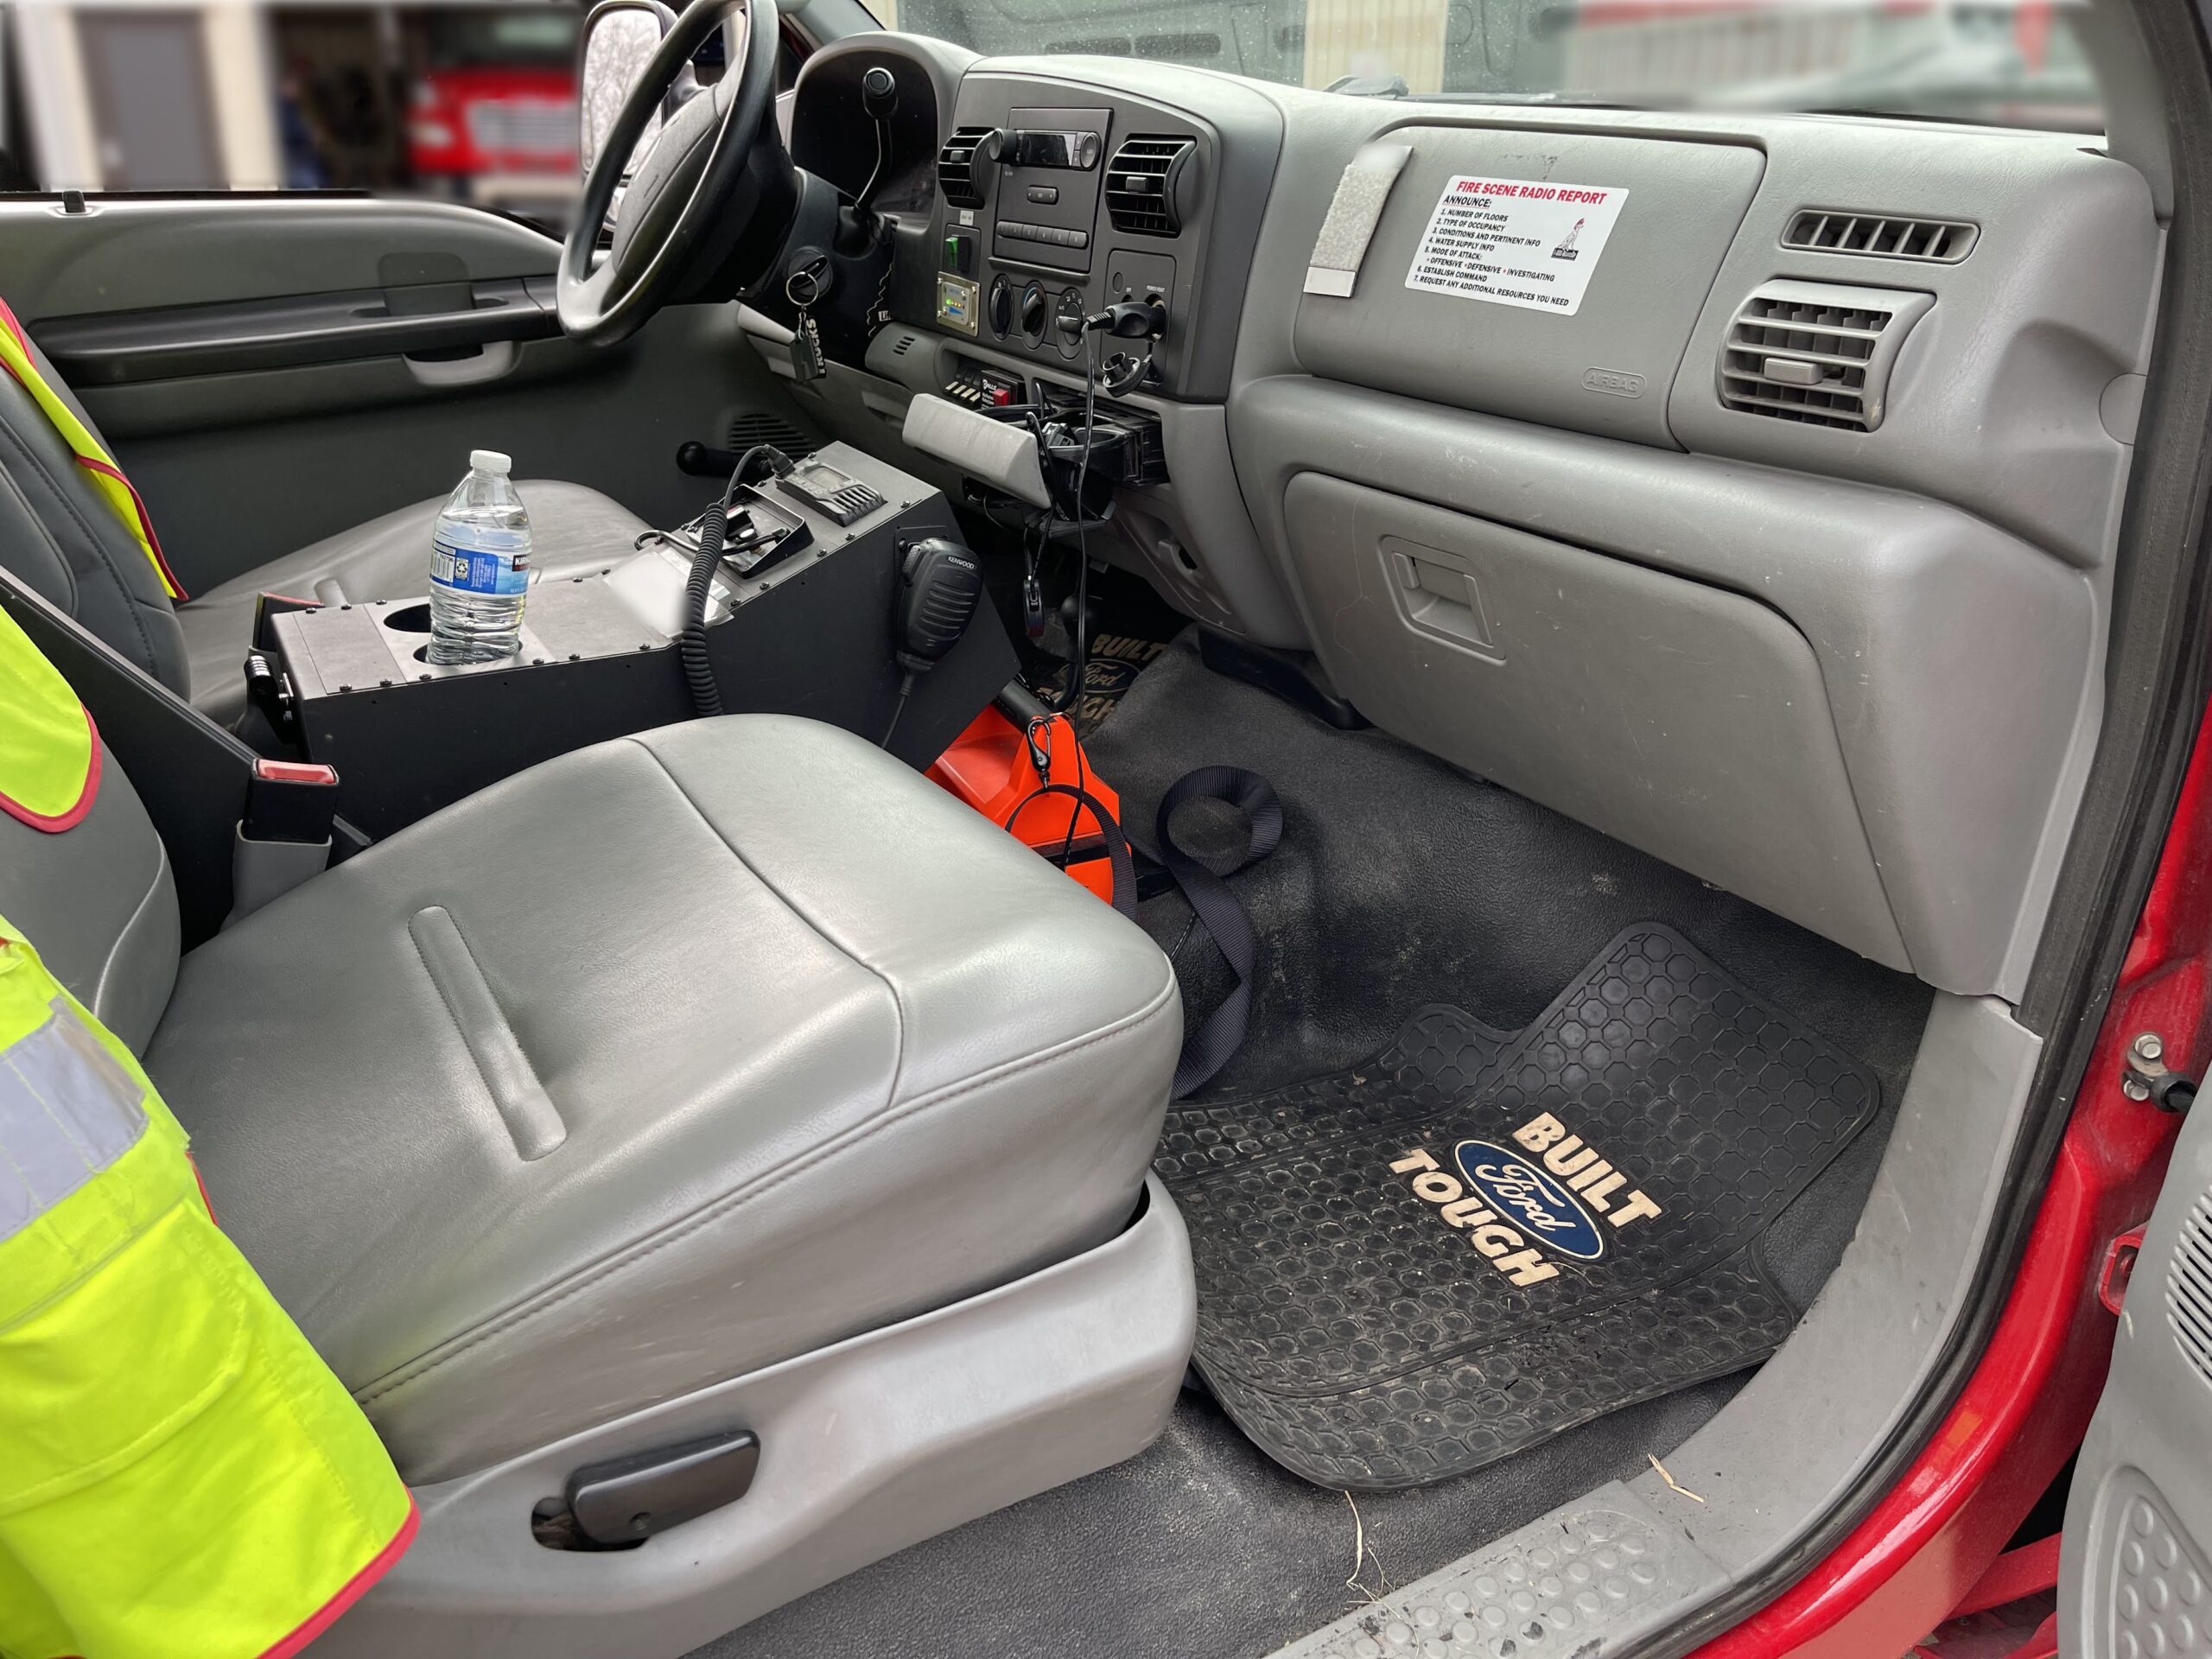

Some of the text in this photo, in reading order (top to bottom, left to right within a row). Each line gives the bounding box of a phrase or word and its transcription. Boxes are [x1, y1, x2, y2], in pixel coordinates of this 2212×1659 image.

[1444, 195, 1492, 207] ANNOUNCE:
[1456, 181, 1607, 205] FIRE SCENE RADIO REPORT
[1447, 209, 1473, 218] NUMBER
[1483, 213, 1508, 222] FLOORS
[1468, 221, 1506, 232] OCCUPANCY
[1435, 238, 1455, 246] WATER
[1455, 240, 1478, 250] SUPPLY
[1479, 243, 1495, 251] INFO
[1439, 228, 1475, 238] CONDITIONS
[1490, 234, 1525, 245] PERTINENT
[1524, 238, 1541, 247] INFO
[1458, 251, 1483, 260] ATTACK:
[1423, 266, 1455, 276] ESTABLISH
[1455, 271, 1488, 282] COMMAND
[1430, 257, 1555, 282] OFFENSIVE DEFENSIVE INVESTIGATING
[1420, 276, 1446, 286] REQUEST
[1459, 283, 1496, 295] ADDITIONAL
[1497, 288, 1535, 301] RESOURCES
[1550, 297, 1569, 306] NEED
[947, 556, 975, 569] KENWOOD
[1091, 633, 1168, 661] BUILT
[1512, 1111, 1662, 1228] BUILT
[1475, 1164, 1577, 1232] Ford
[1389, 1148, 1560, 1287] TOUGH
